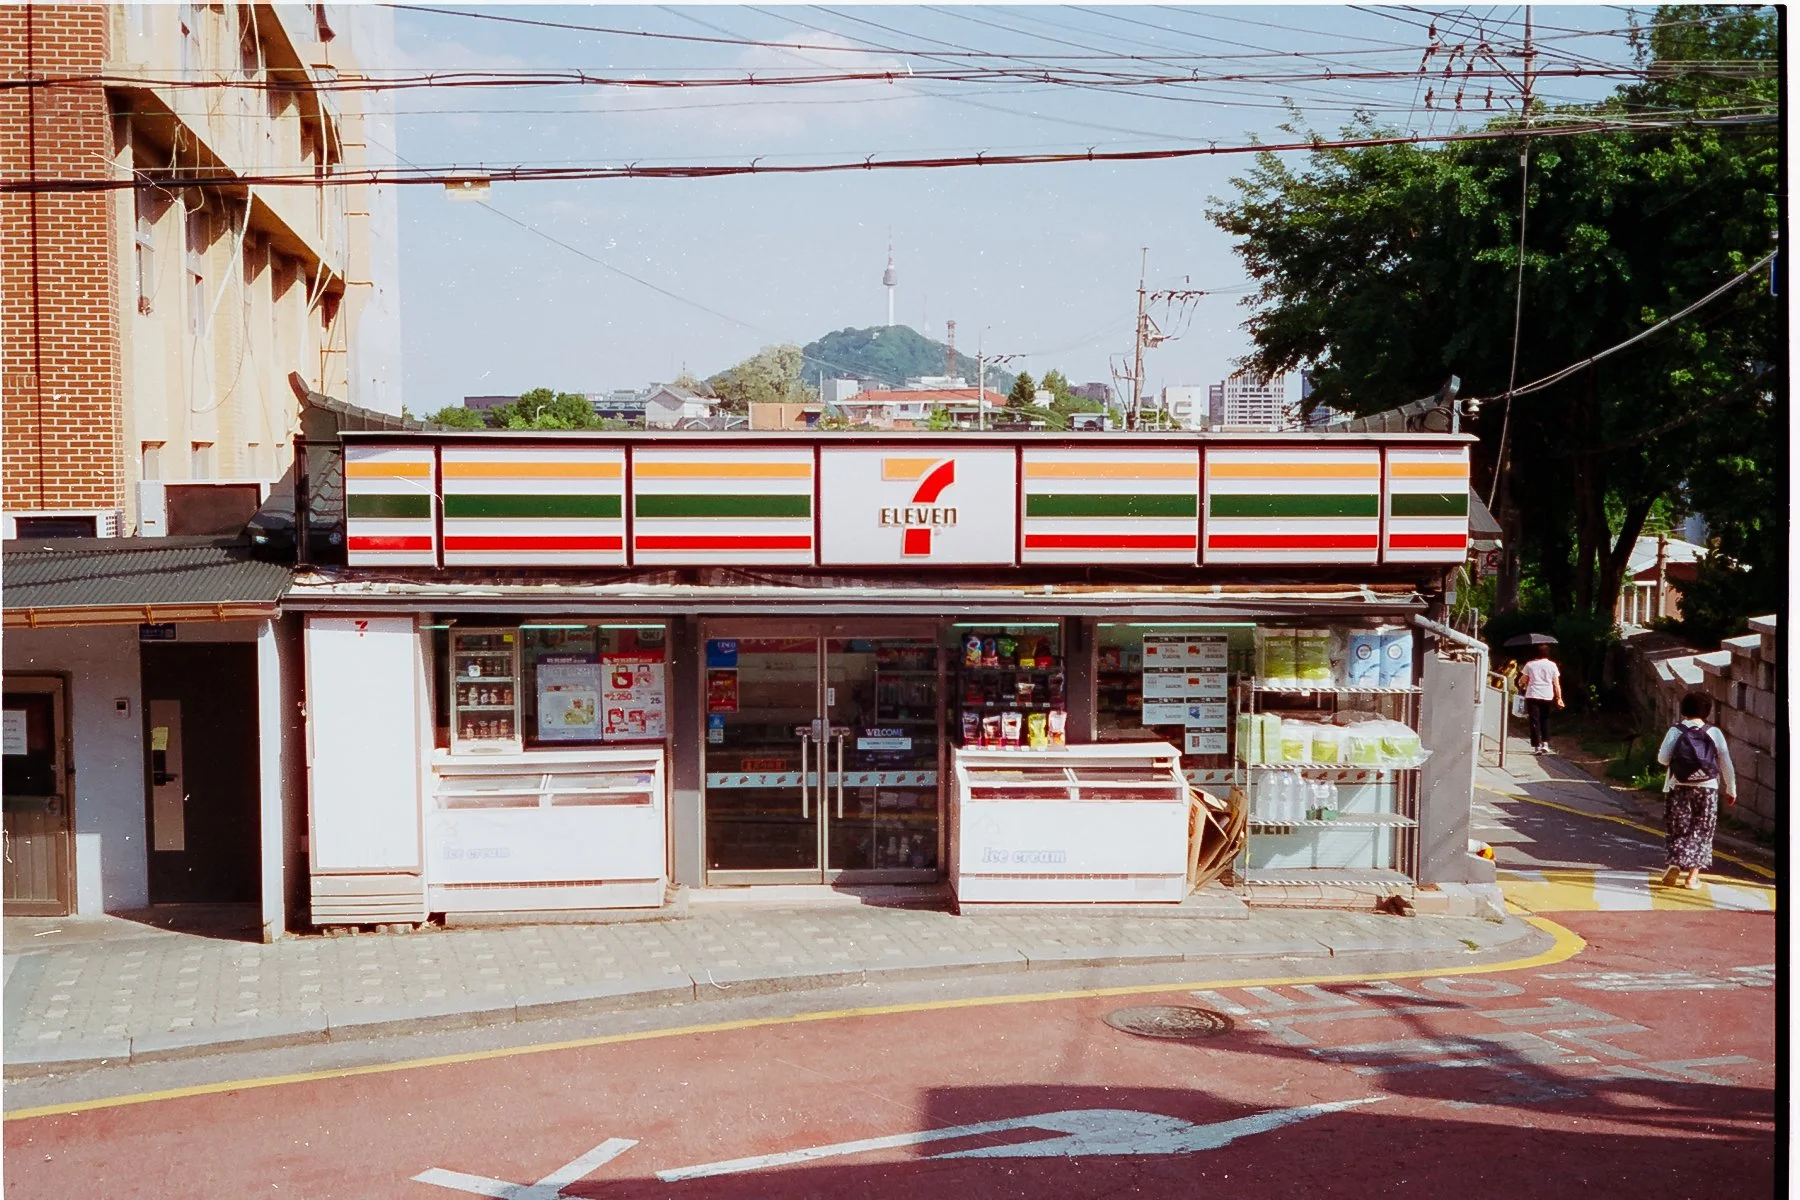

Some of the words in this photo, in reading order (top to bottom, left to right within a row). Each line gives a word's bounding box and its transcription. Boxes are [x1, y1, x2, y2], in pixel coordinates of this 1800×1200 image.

[882, 458, 955, 556] 7
[866, 728, 904, 737] WELCOME
[982, 847, 1008, 863] Ice
[1011, 850, 1067, 864] cream
